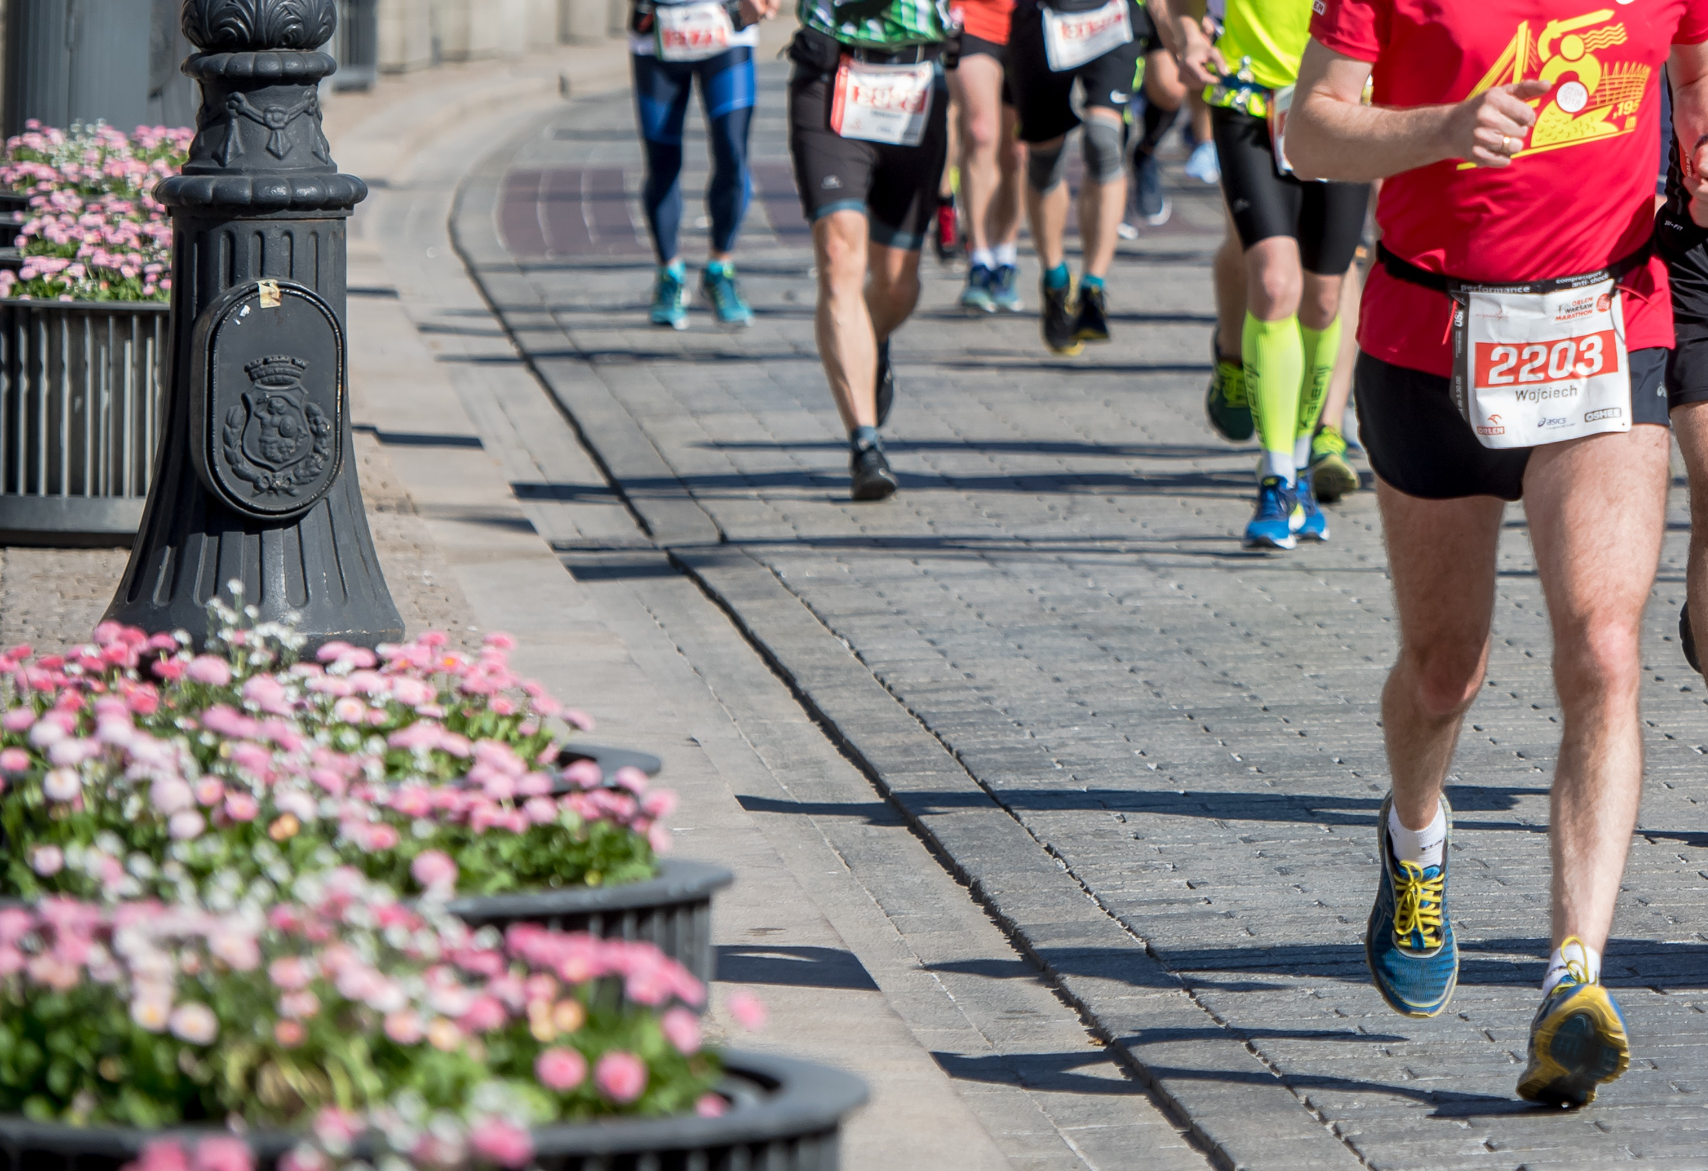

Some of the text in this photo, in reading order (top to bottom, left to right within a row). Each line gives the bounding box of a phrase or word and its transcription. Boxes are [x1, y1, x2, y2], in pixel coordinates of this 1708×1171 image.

[1460, 284, 1531, 294] performance
[1571, 296, 1594, 307] ORLEN
[1564, 303, 1593, 314] WARSAW
[1555, 309, 1593, 322] MARATHON
[1488, 334, 1603, 385] 2203
[1515, 384, 1578, 404] Wojciech
[1585, 410, 1622, 423] OSHEE
[1477, 427, 1504, 435] ORLEN
